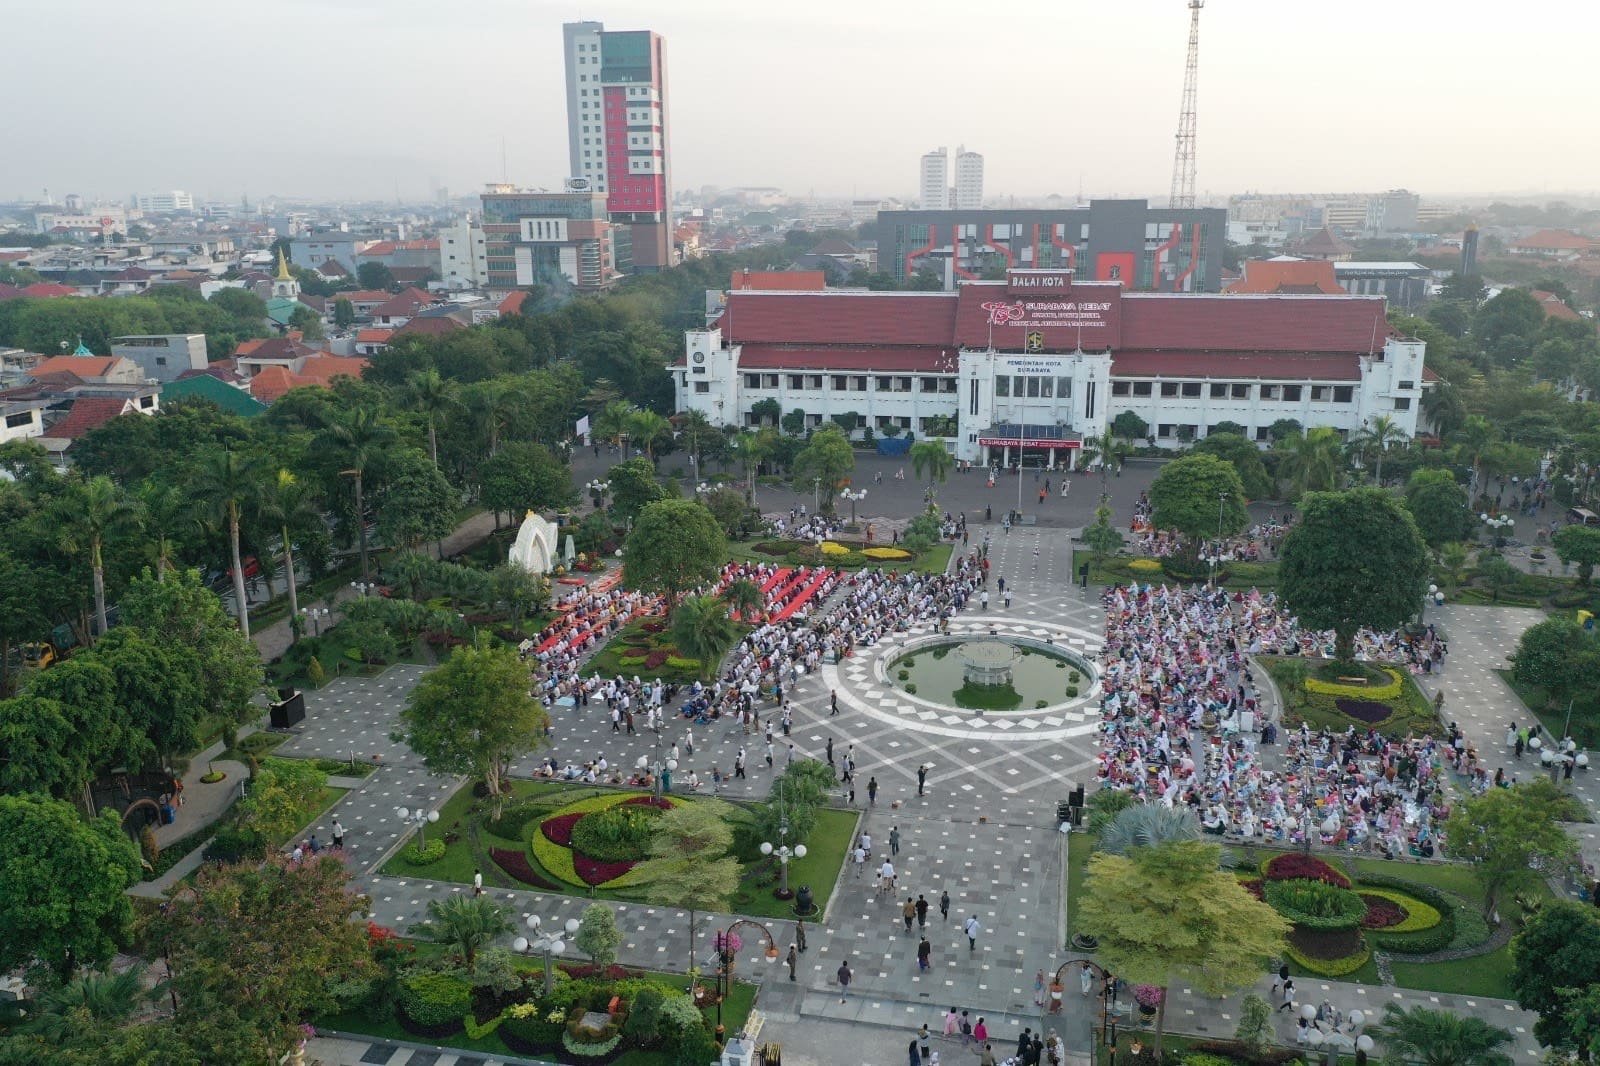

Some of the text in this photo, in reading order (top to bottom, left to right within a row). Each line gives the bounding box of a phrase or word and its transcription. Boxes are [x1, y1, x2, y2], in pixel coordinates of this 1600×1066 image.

[1012, 277, 1064, 287] BALAI KOTA
[1025, 302, 1112, 311] SURABAYA HEBAT
